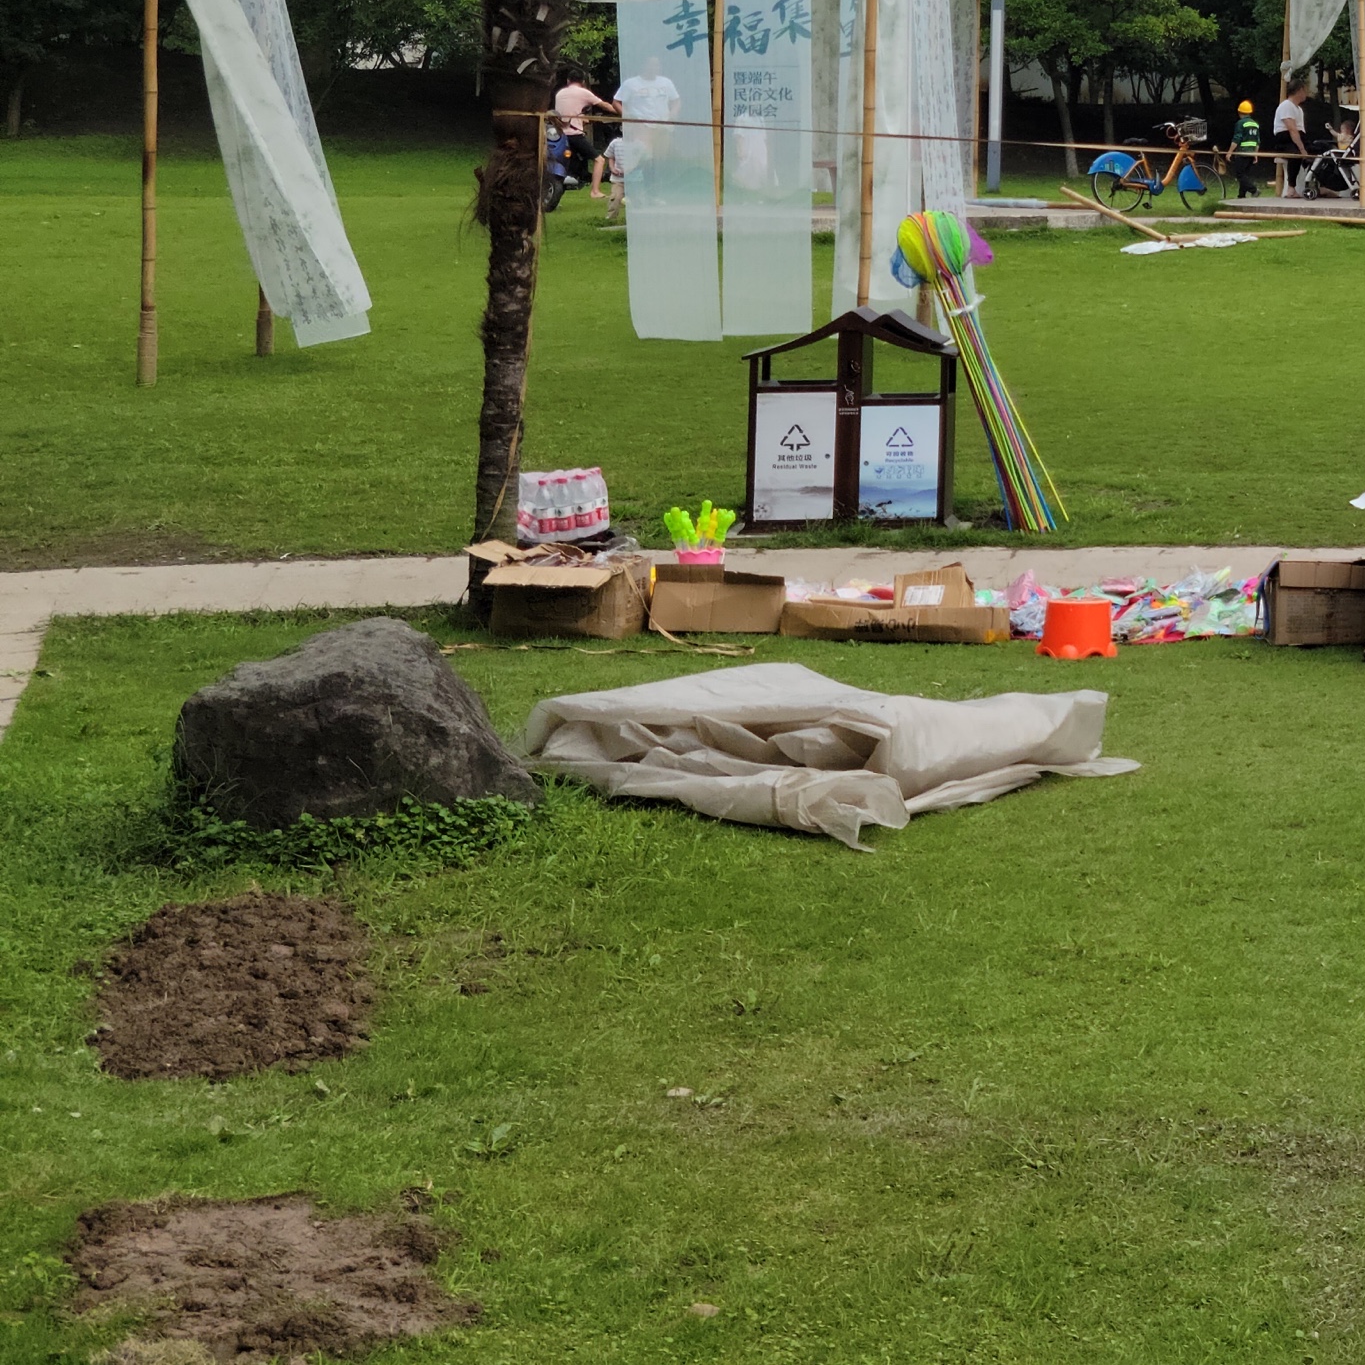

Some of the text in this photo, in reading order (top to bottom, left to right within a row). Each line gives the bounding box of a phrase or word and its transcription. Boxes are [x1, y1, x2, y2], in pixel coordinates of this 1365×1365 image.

[733, 70, 777, 86] 暨端午
[733, 87, 793, 102] 民俗文化
[732, 103, 778, 118] 游园会
